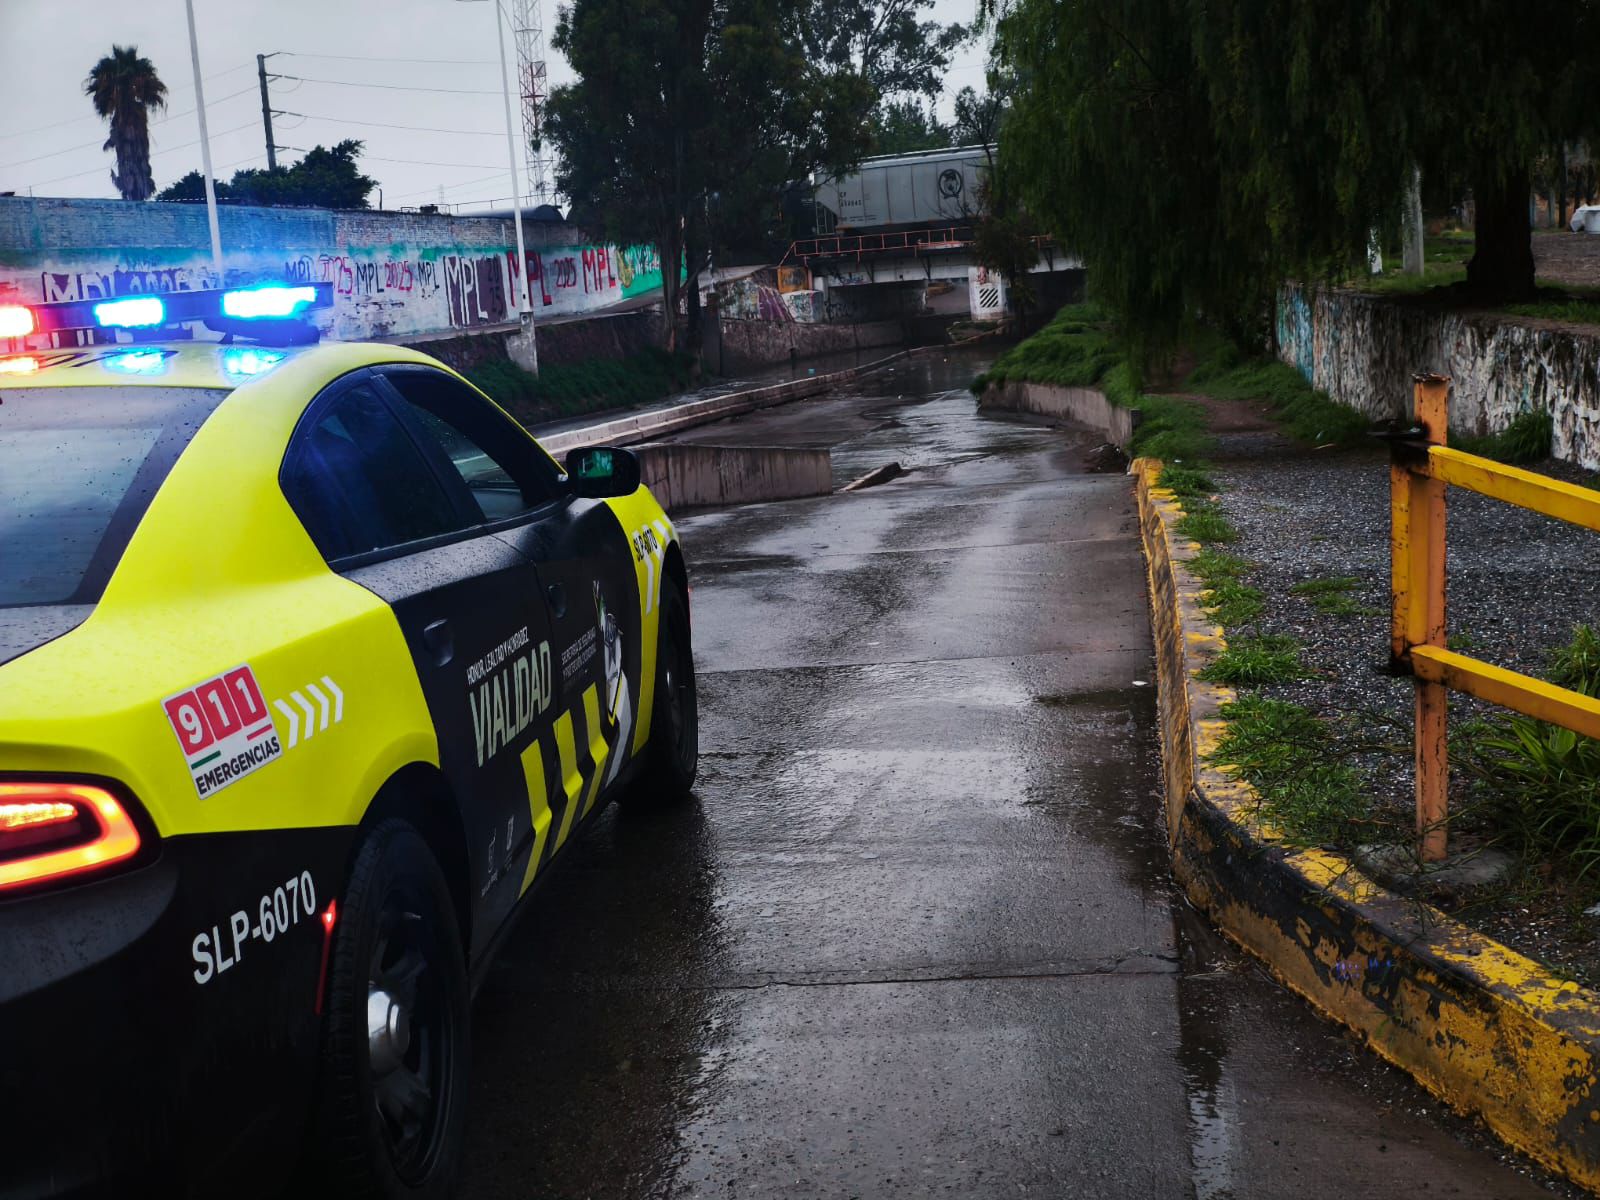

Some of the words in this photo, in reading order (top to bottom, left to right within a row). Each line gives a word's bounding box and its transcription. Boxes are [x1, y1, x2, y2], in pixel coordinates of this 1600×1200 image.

[355, 262, 385, 295] MPL
[384, 260, 413, 292] 2025
[417, 260, 440, 289] MPL
[443, 255, 489, 329] MPL
[581, 247, 616, 294] MPL
[177, 676, 258, 745] 911
[469, 639, 551, 768] VIALIDAD
[195, 735, 281, 796] EMERGENCIAS
[191, 870, 317, 985] SLP-6070
